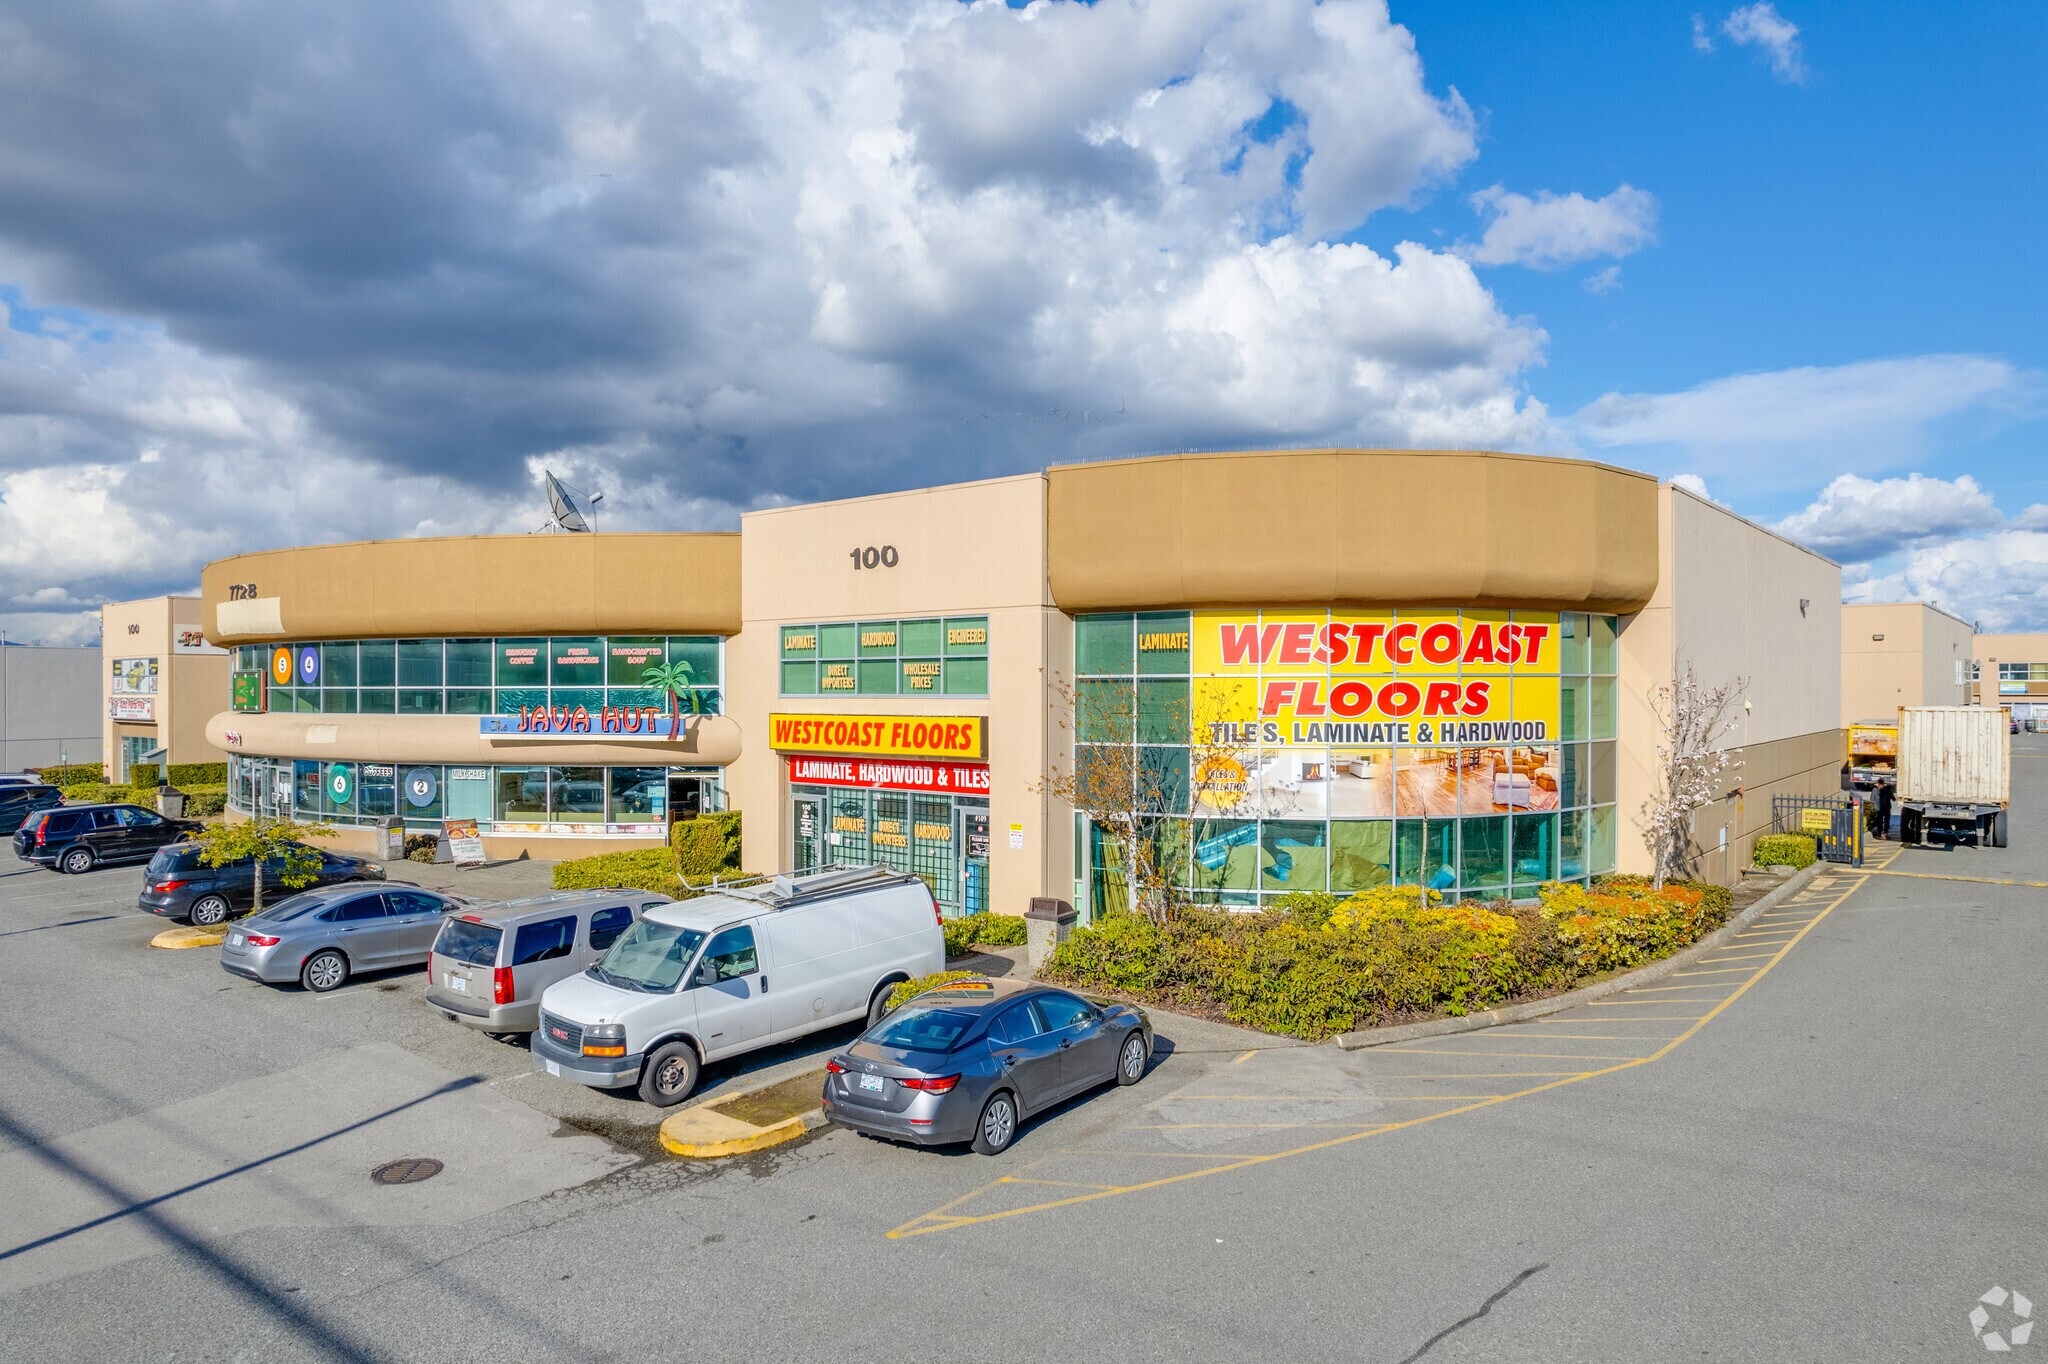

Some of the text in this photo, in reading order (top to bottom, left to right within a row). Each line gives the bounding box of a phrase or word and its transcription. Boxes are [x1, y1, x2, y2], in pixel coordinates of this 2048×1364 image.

[850, 545, 899, 570] 100
[127, 623, 140, 635] 100
[948, 628, 987, 646] ENGINEERED
[784, 635, 816, 650] LAMINATE
[861, 631, 896, 648] HARDWOOD
[1139, 633, 1189, 651] LAMINATE
[1219, 621, 1549, 666] WESTCOAST
[828, 665, 848, 677] DIRECT
[904, 663, 940, 676] WHOLESALE
[822, 677, 855, 689] IMPORTERS
[911, 677, 932, 689] PRICES
[1261, 680, 1491, 718] FLOORS
[517, 704, 591, 732] JAVA
[602, 705, 661, 732] HUT
[776, 719, 973, 750] WESTCOAST FLOORS
[1210, 721, 1547, 745] TILES, LAMINATE & HARDWOOD
[363, 766, 393, 777] COFFEES
[795, 760, 990, 789] LAMINATE, HARDWOOD & TILES
[832, 816, 865, 833] LAMINATE
[878, 820, 901, 833] DIRECT
[914, 824, 950, 841] HARDWOOD
[872, 832, 907, 847] IMPORTERS
